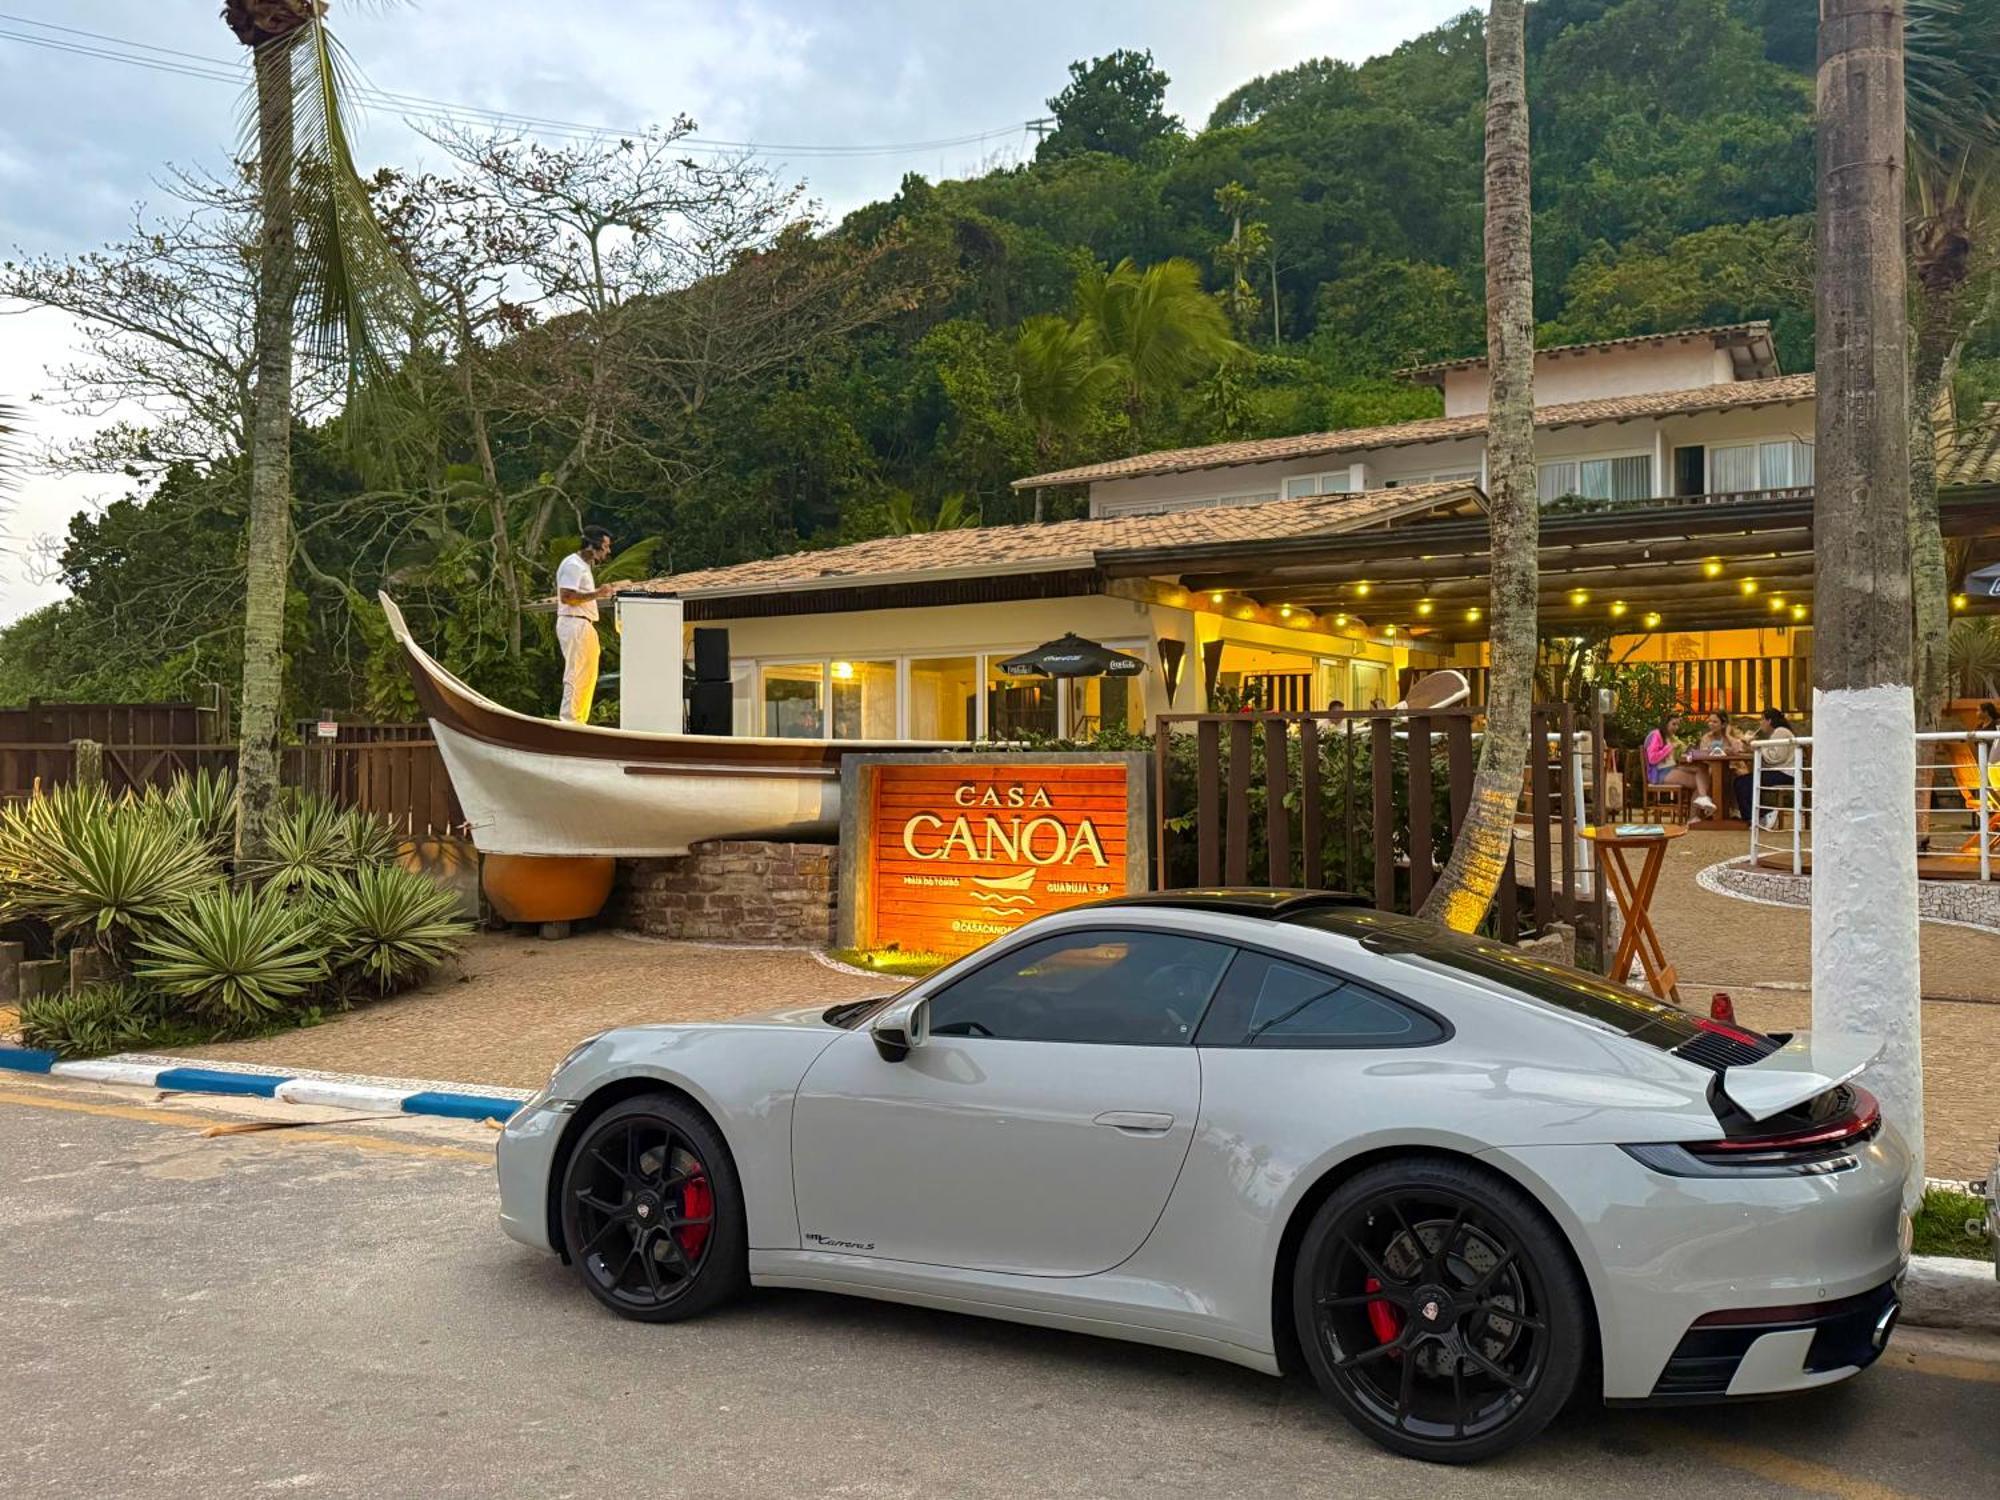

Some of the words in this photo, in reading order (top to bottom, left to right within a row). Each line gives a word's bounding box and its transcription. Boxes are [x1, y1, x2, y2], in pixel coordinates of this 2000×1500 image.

[955, 786, 1051, 808] CASA
[903, 815, 1109, 867] CANOA
[818, 1236, 864, 1249] Carrera
